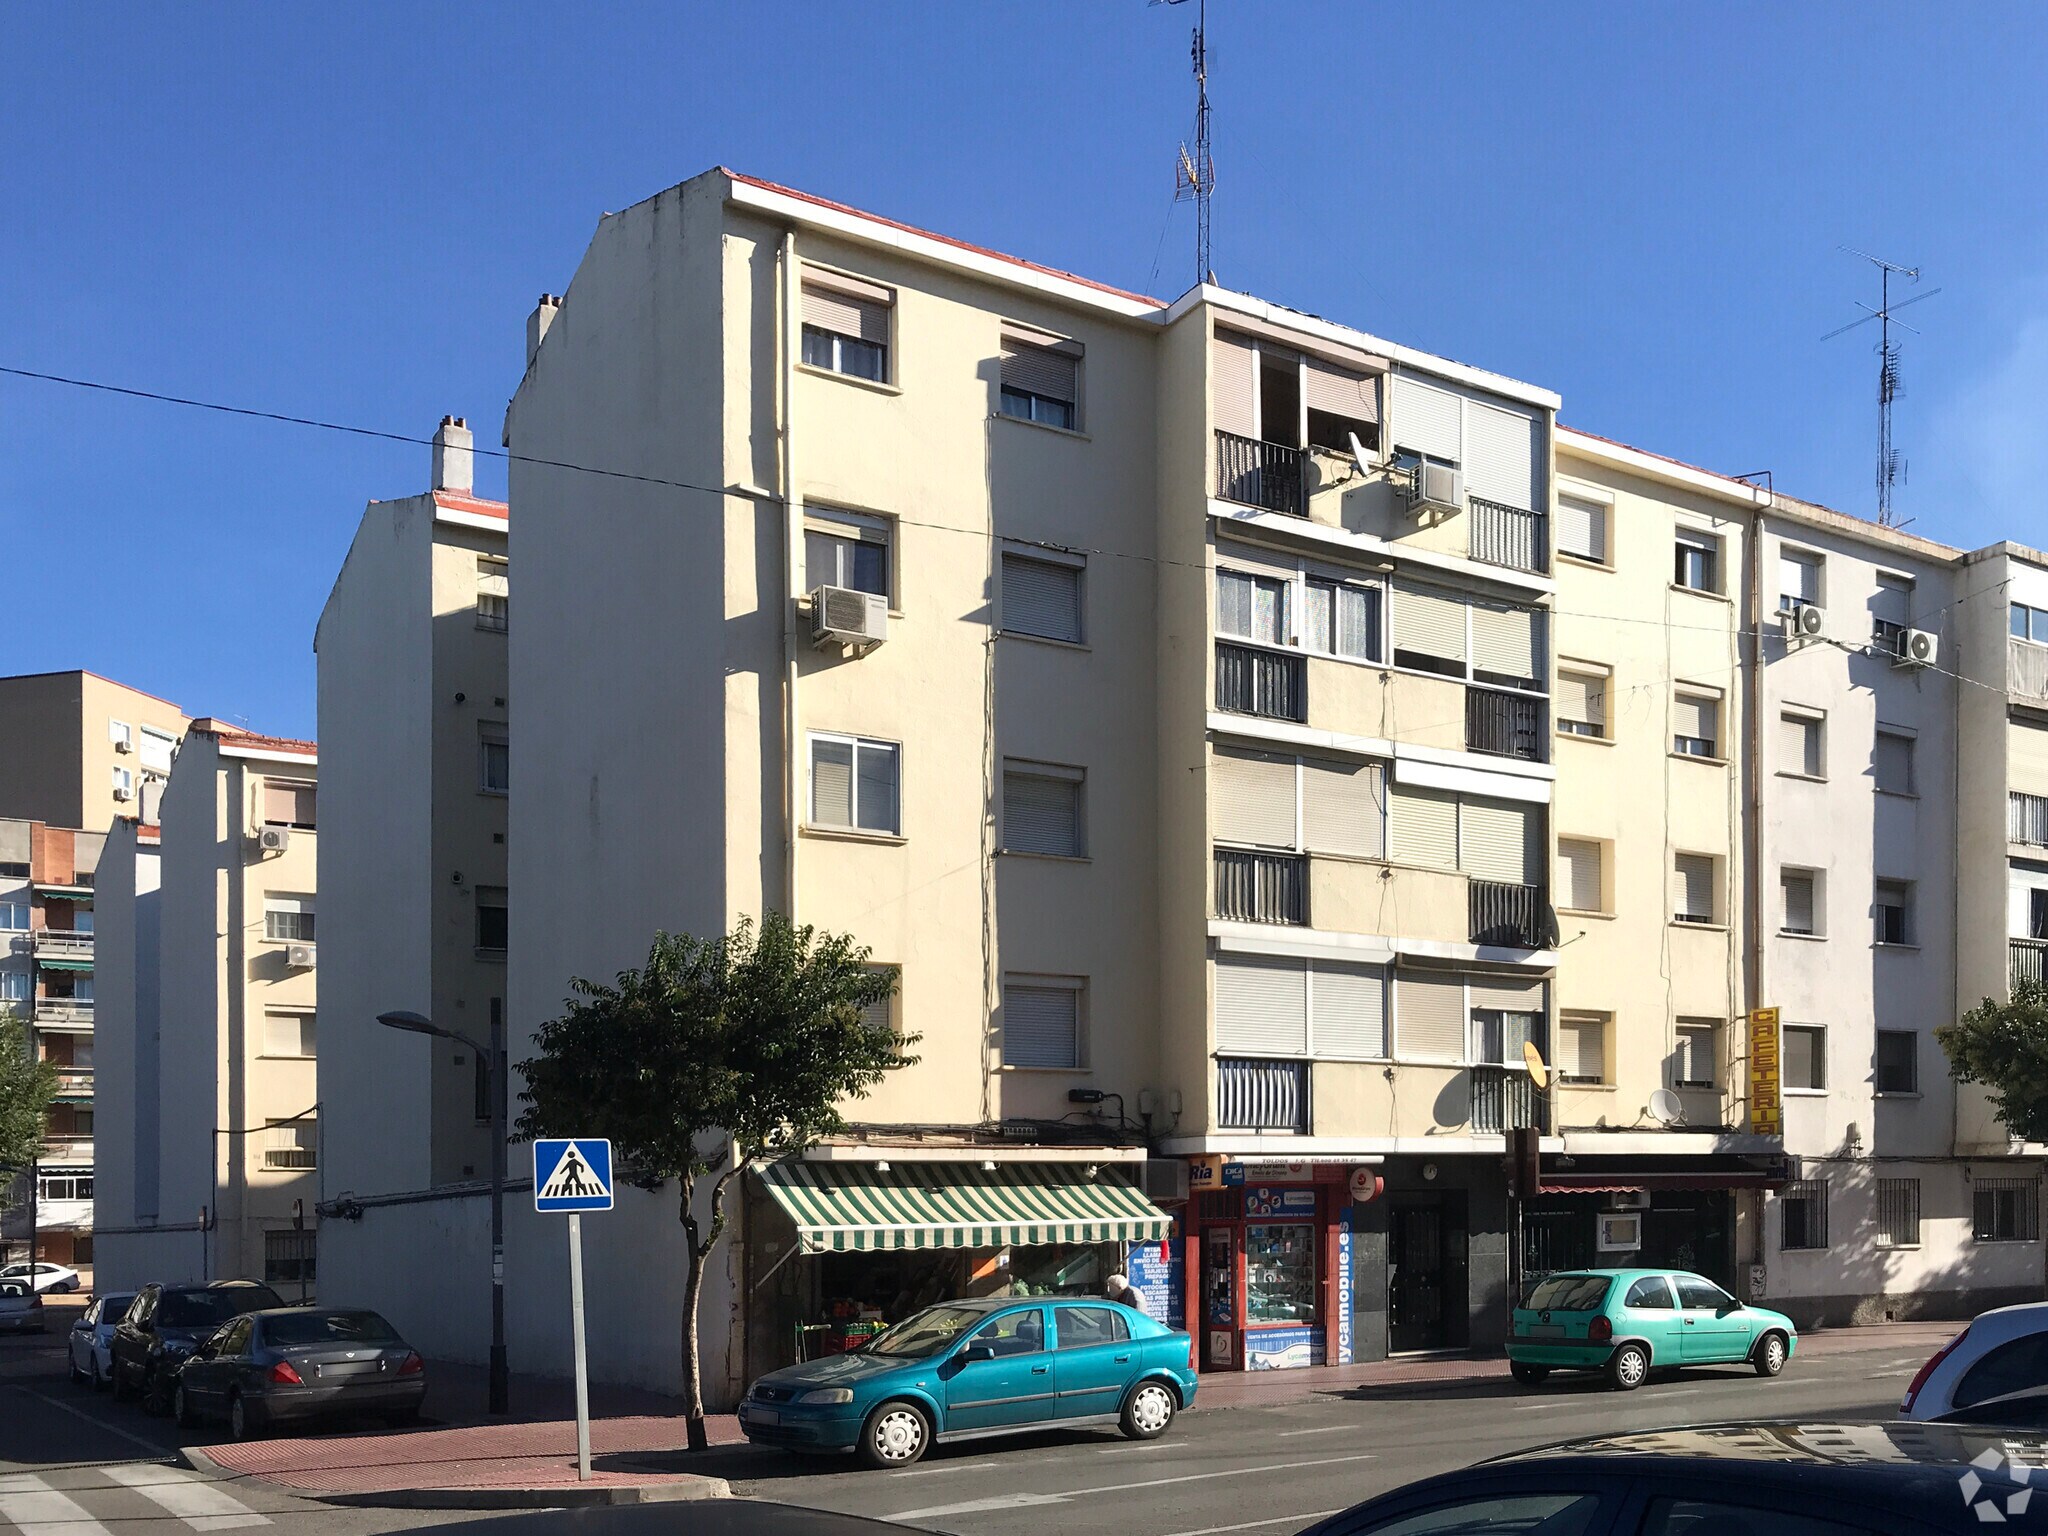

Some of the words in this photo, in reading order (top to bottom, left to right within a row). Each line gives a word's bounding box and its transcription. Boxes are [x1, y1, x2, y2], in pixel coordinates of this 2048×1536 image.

[1752, 1010, 1775, 1135] CAFETERIA
[1190, 1160, 1213, 1180] Ria
[1287, 1350, 1323, 1360] Lycamobile
